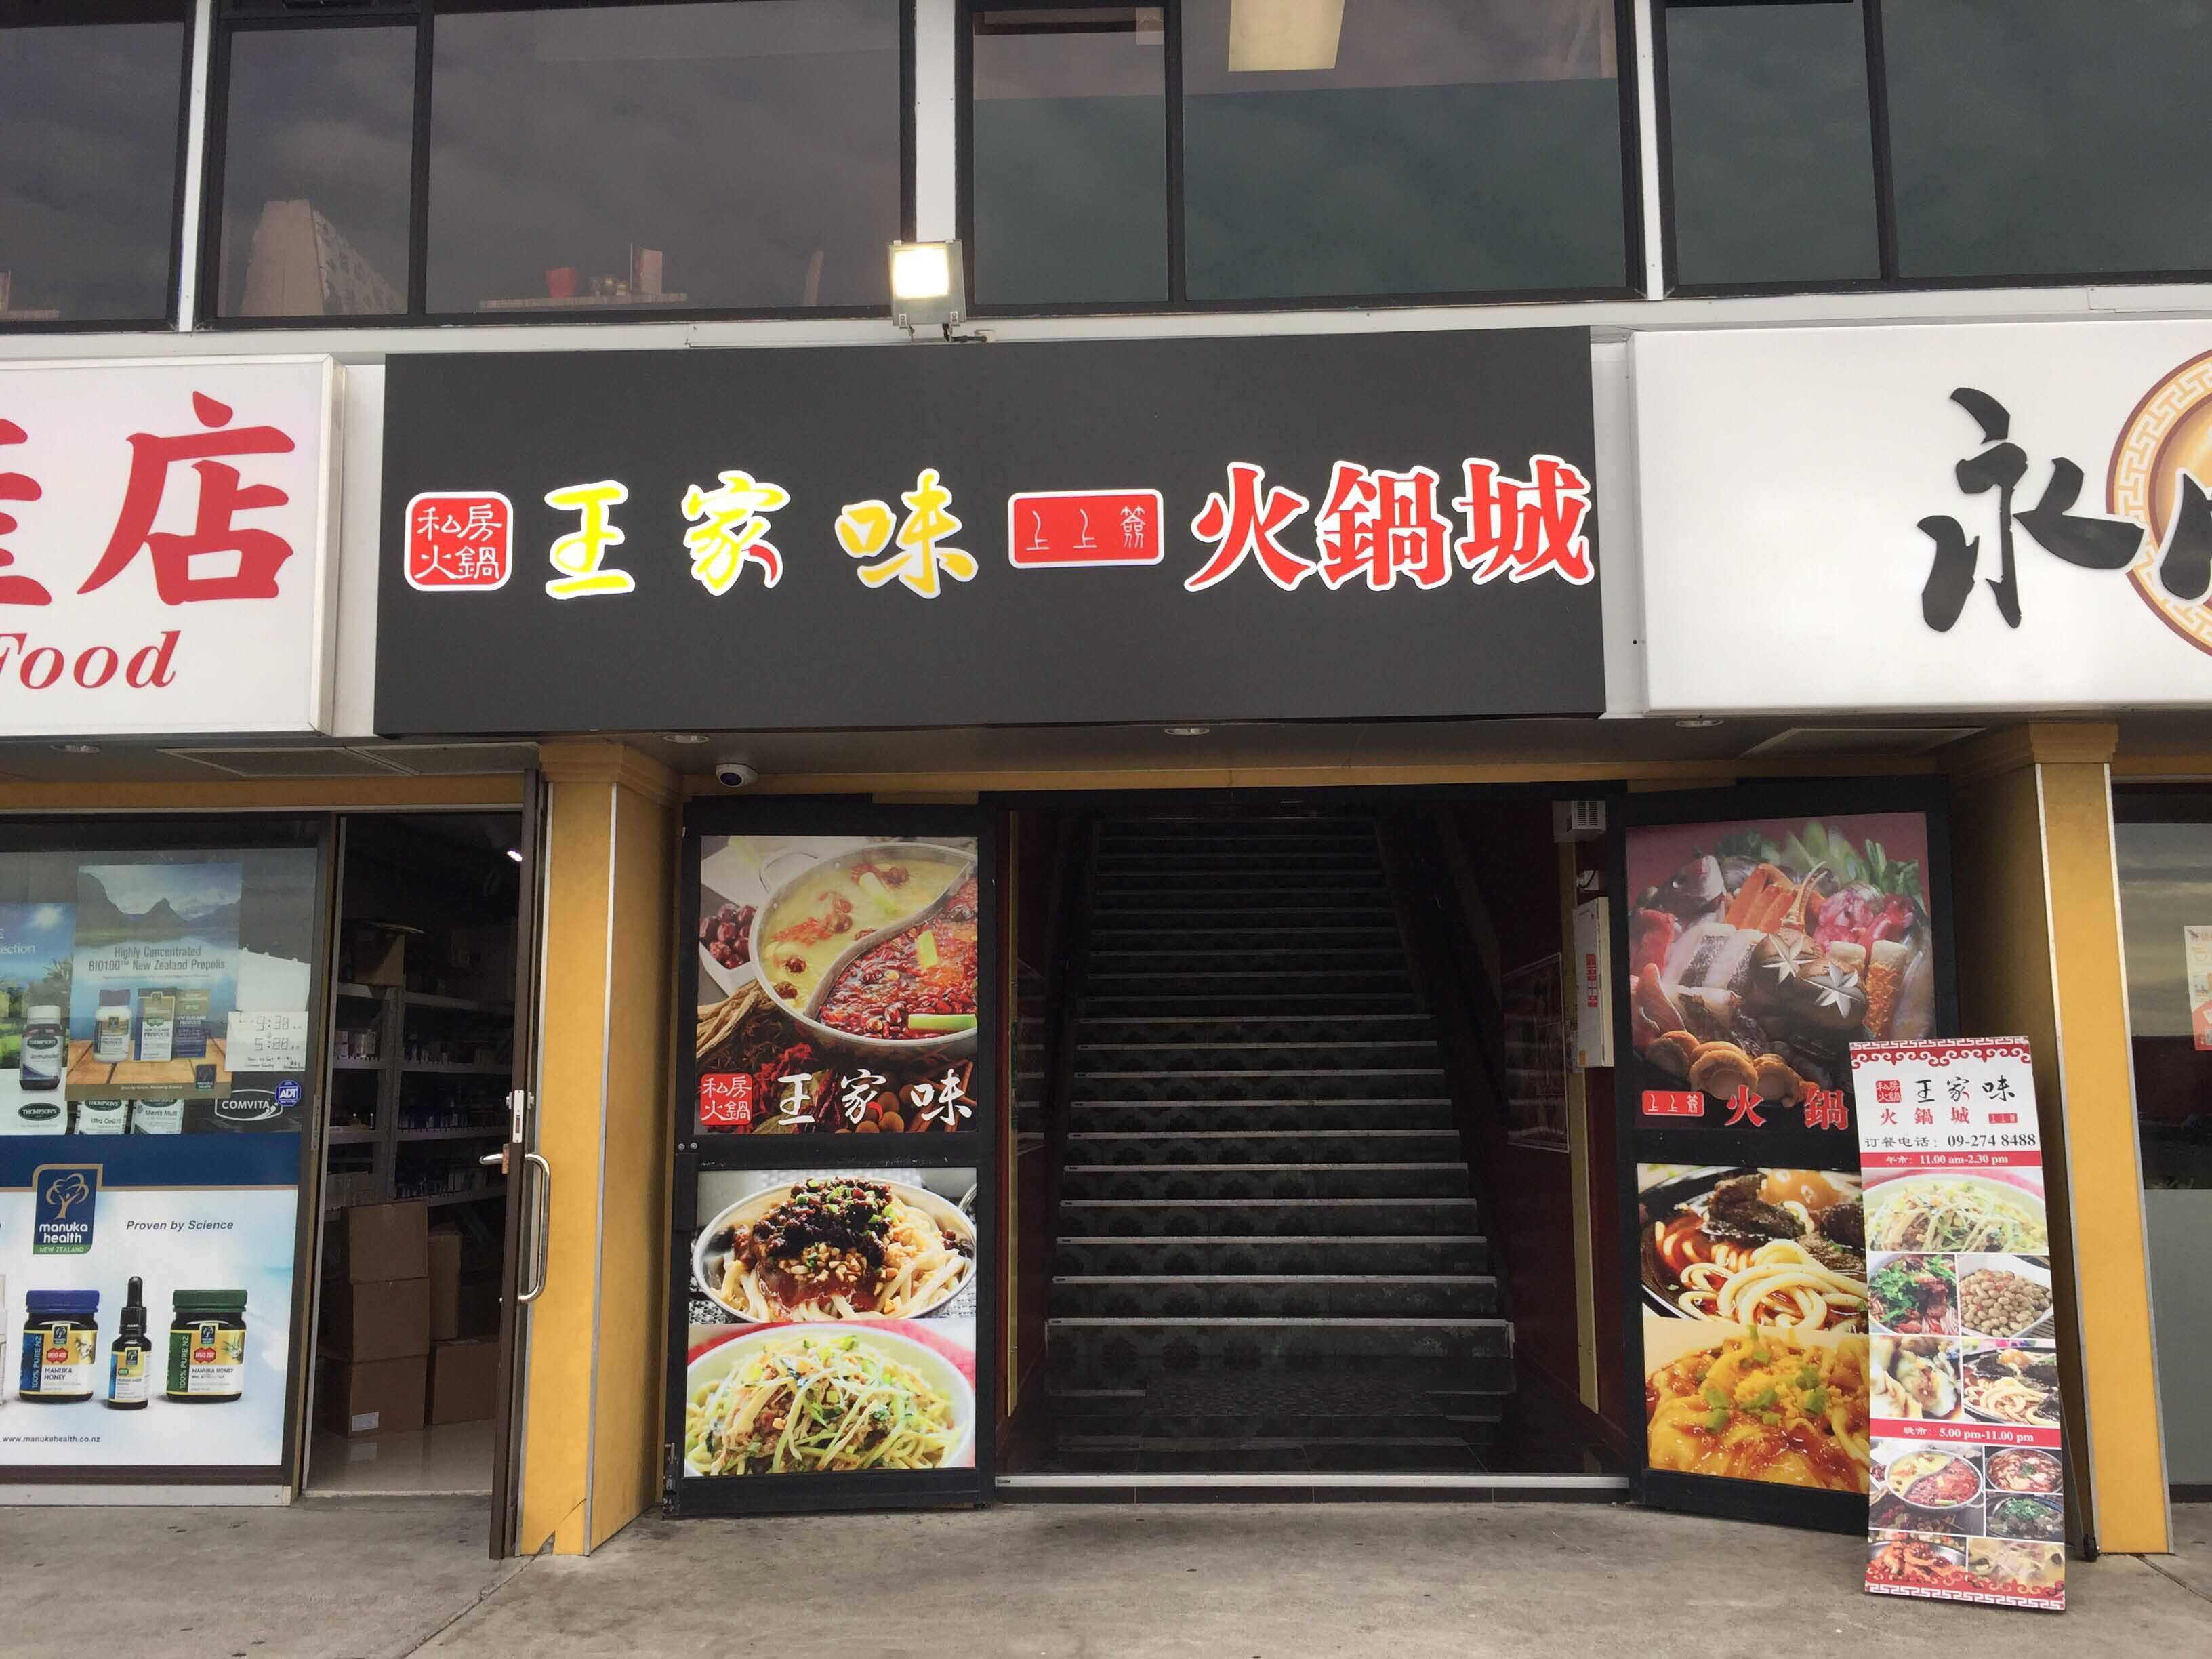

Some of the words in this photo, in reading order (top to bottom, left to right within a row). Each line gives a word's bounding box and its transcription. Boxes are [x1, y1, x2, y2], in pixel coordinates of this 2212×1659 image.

[416, 503, 503, 541] 私房
[1183, 455, 1594, 592] 火鍋城
[544, 468, 979, 600] 王家味
[414, 545, 501, 581] 火鍋
[114, 947, 140, 959] Highly
[144, 946, 201, 957] Concentrated
[132, 960, 151, 971] New
[154, 960, 188, 970] Zealand
[191, 959, 226, 971] Propolis
[279, 1088, 298, 1099] ADT
[703, 1076, 752, 1099] 私房
[1915, 1075, 2016, 1103] 王家味
[222, 1100, 270, 1110] COMVITA
[777, 1068, 972, 1126] 王家味
[701, 1101, 751, 1122] 火鍋
[1881, 1107, 1970, 1125] 火鍋城
[1948, 1134, 1996, 1147] 09-274
[2001, 1134, 2036, 1146] 8488
[1920, 1155, 1946, 1164] 11.00
[1991, 1155, 2009, 1165] pm
[39, 1221, 88, 1232] manuka
[126, 1221, 167, 1231] Proven
[170, 1220, 184, 1232] by
[188, 1220, 234, 1230] Science
[43, 1233, 82, 1243] health
[180, 1347, 188, 1368] PURE
[1939, 1427, 1961, 1437] 5.00
[1964, 1430, 2013, 1441] pm-11.00
[2016, 1433, 2034, 1443] pm
